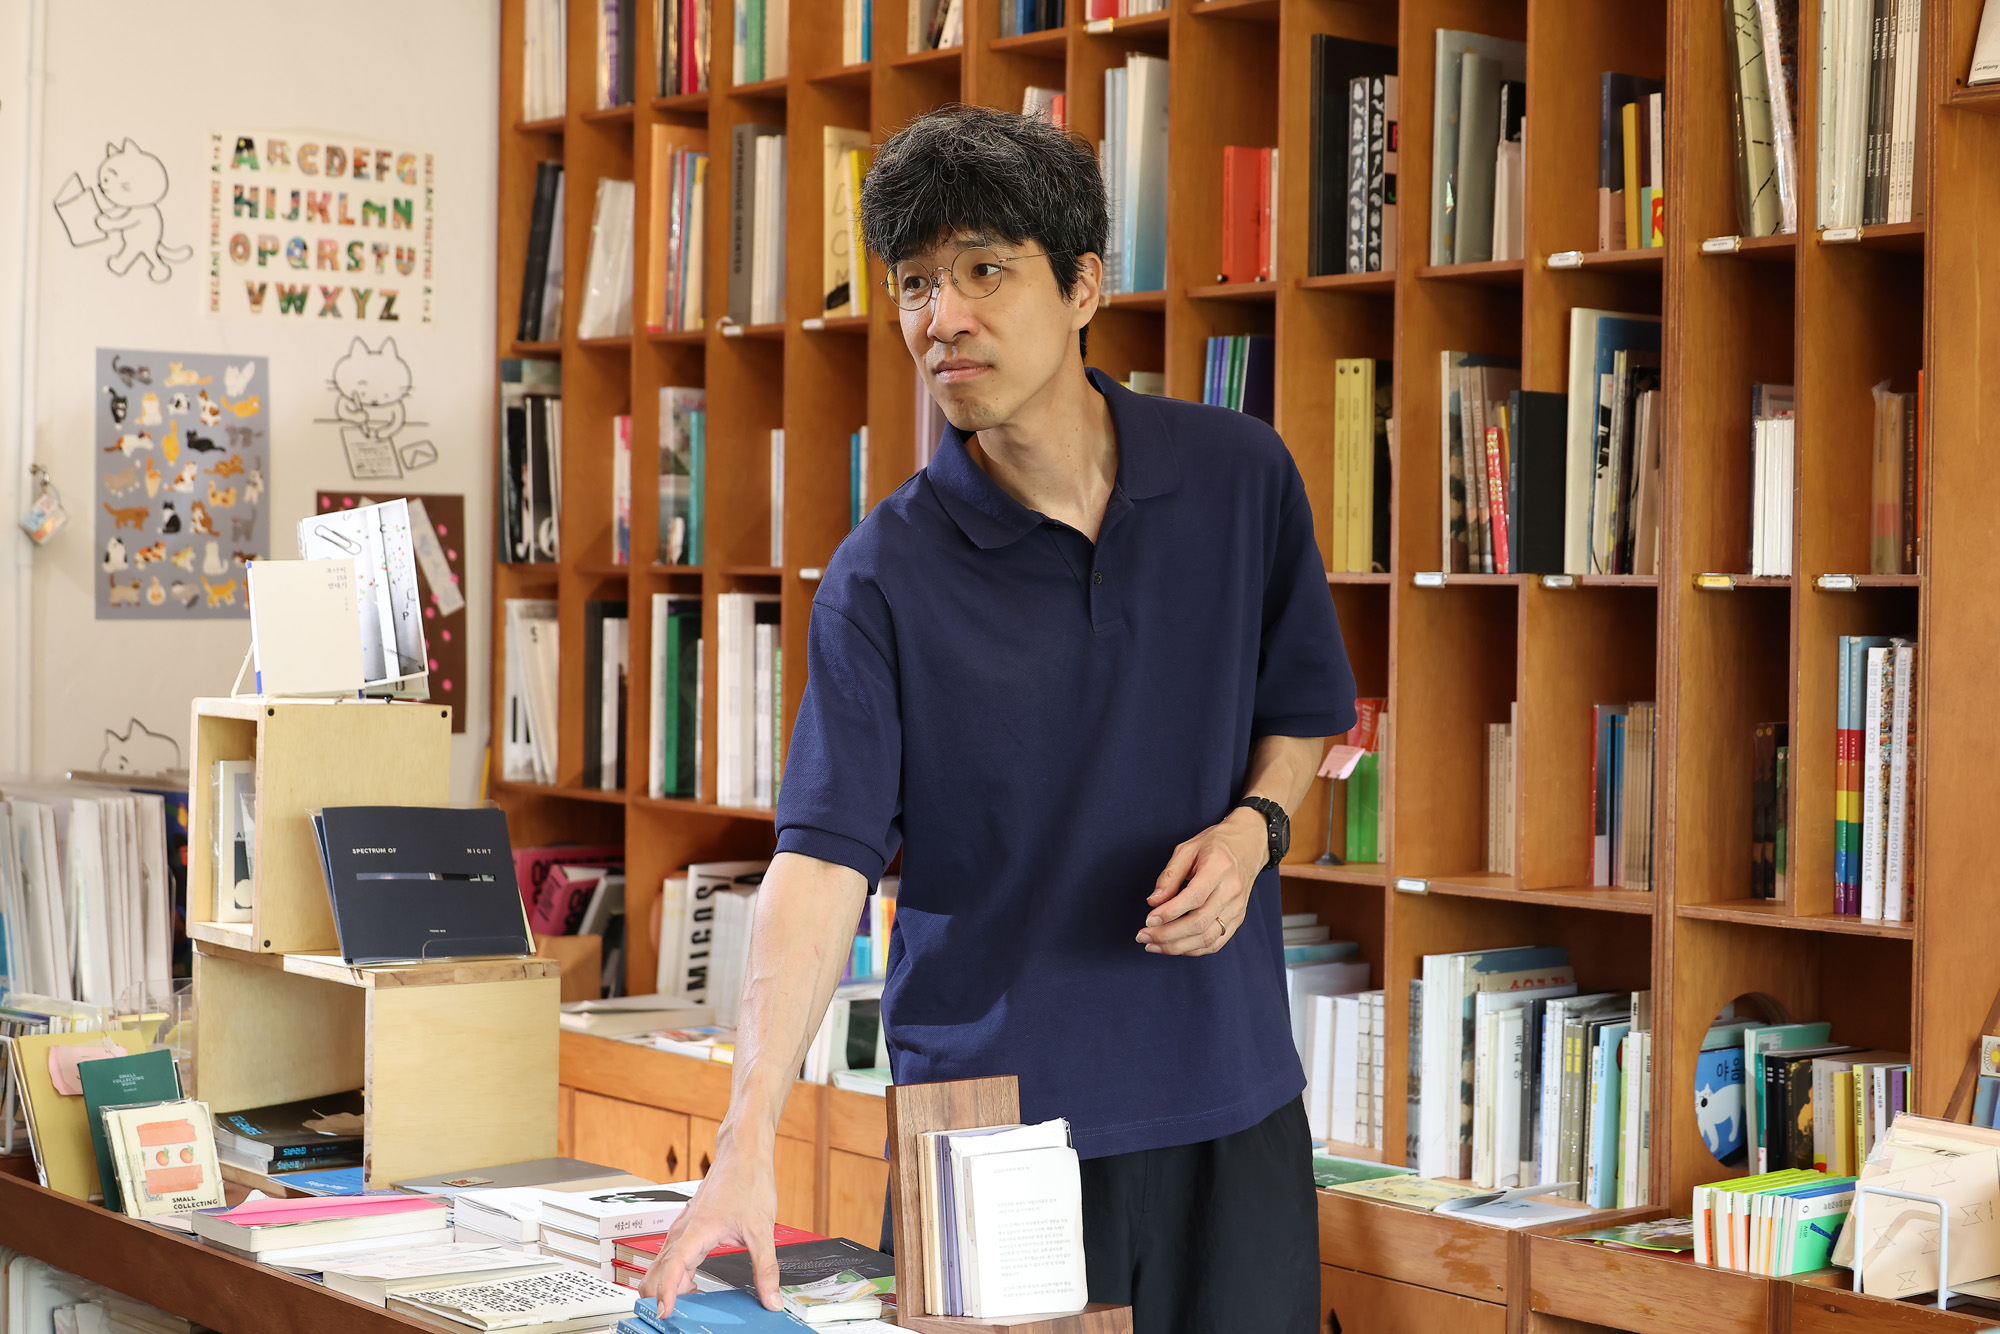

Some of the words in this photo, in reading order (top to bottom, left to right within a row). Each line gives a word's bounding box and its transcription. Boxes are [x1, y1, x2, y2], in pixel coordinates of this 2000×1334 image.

[1868, 728, 1876, 755] TOYS
[1896, 727, 1904, 755] TOYS
[1865, 775, 1875, 812] OTHER
[1892, 775, 1902, 812] OTHER
[1863, 814, 1875, 883] MEMORIALS
[1889, 814, 1900, 883] MEMORIALS
[172, 1195, 196, 1203] SMALL
[173, 1199, 218, 1210] COLLECTING
